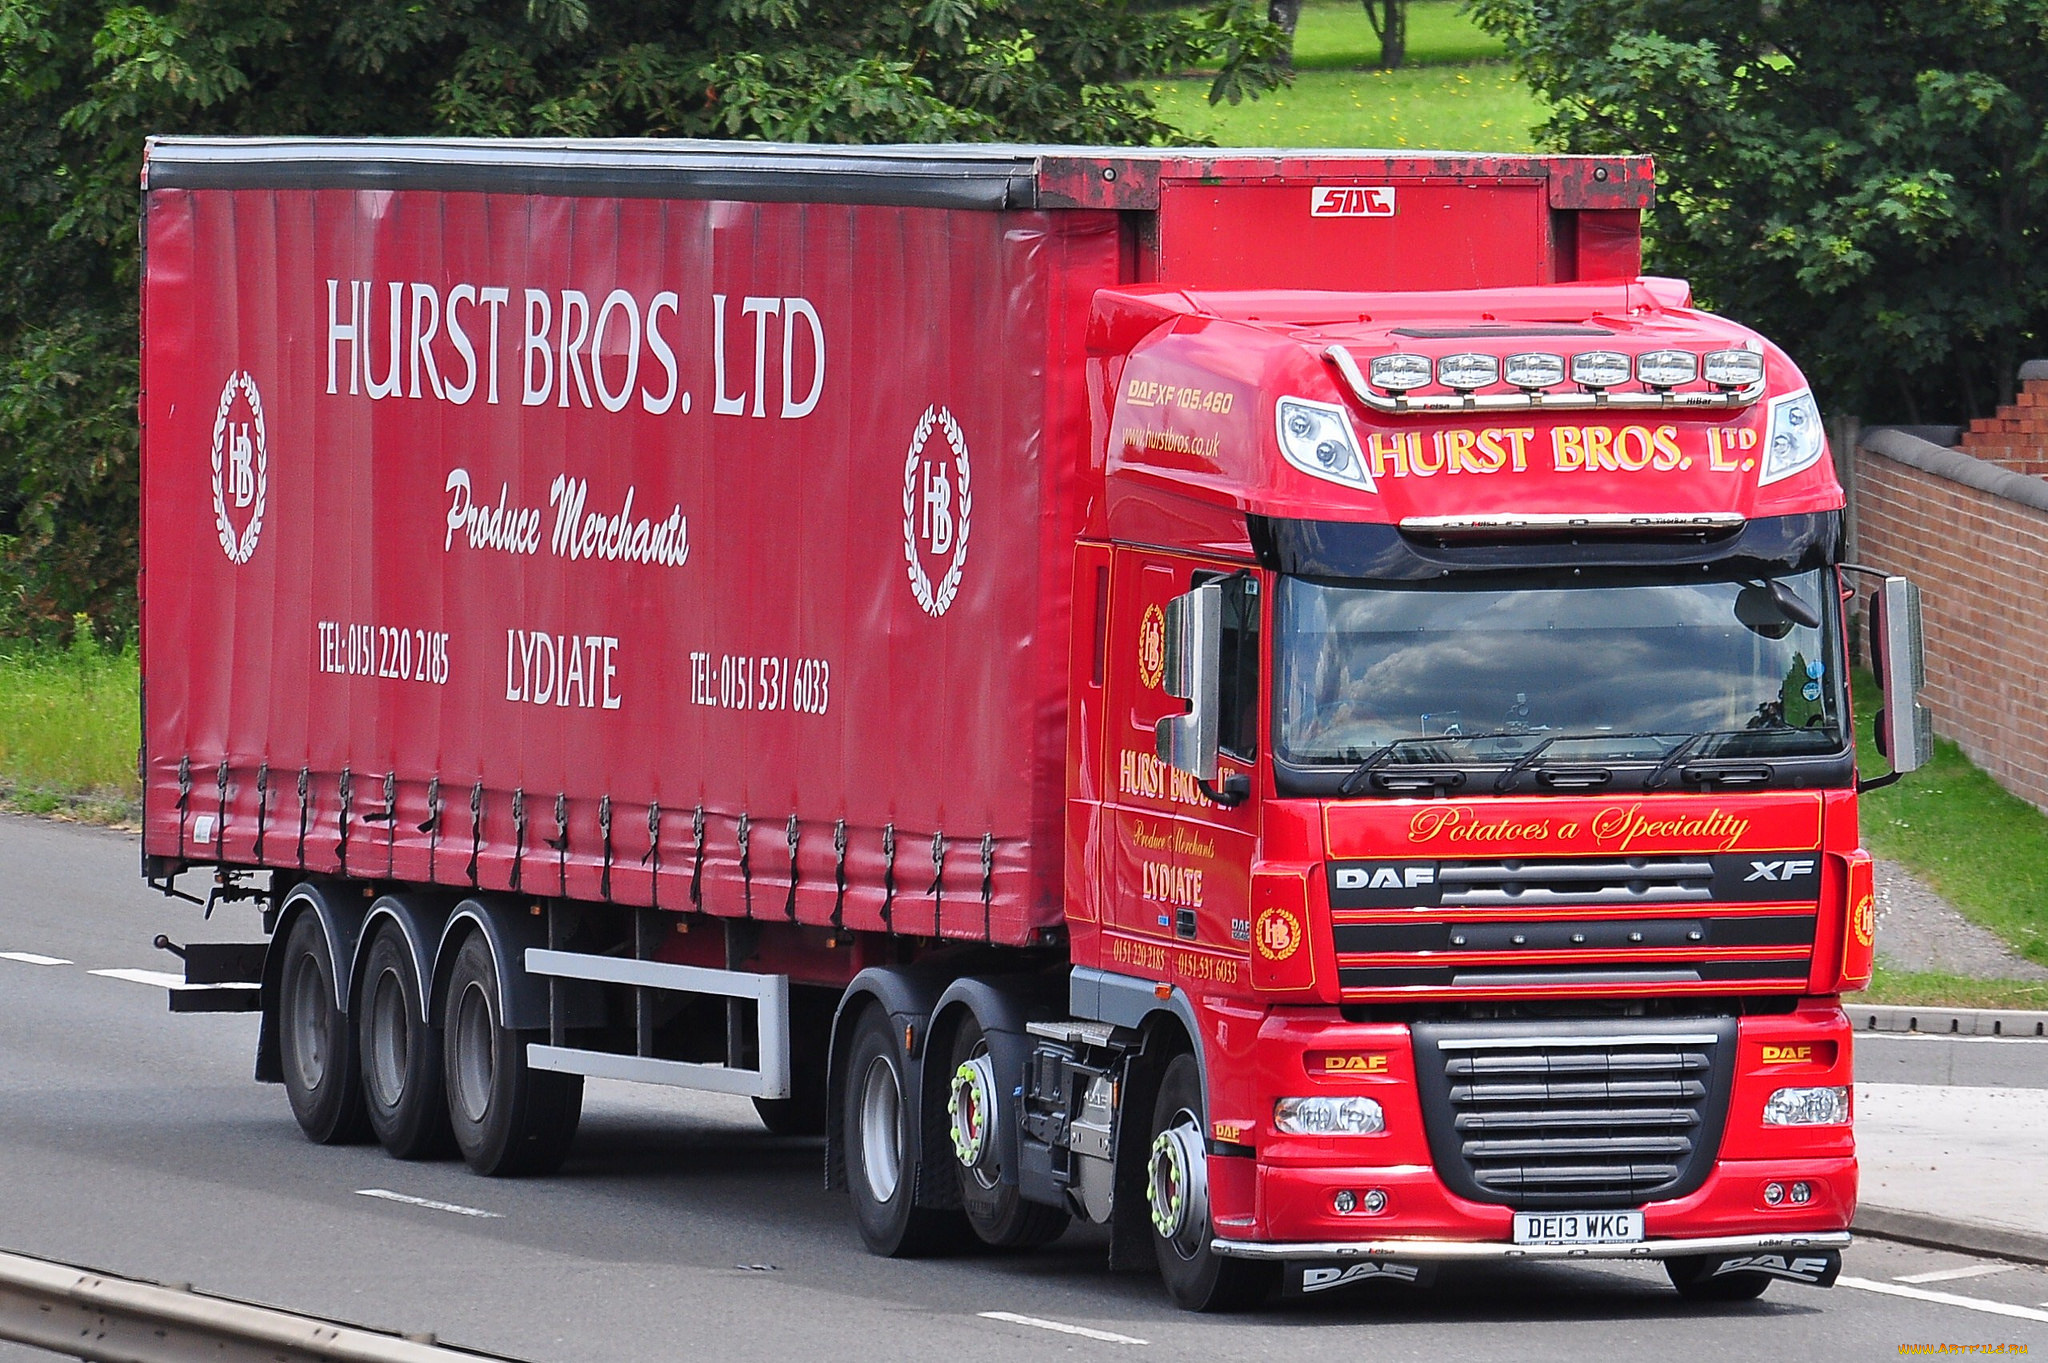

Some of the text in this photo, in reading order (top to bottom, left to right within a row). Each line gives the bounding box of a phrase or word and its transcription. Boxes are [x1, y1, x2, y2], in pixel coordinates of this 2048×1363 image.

[1315, 189, 1391, 214] SDC
[326, 279, 825, 420] HURST BROS. LTD
[1127, 380, 1233, 414] DAF XF 105.460
[1122, 422, 1220, 457] www.hurstbros.co.uk
[1366, 427, 1535, 478] HURST
[1550, 424, 1693, 473] BROS.
[445, 468, 690, 567] Produce Merchants
[318, 621, 449, 685] TEL: 0151 220 2185
[506, 629, 622, 709] LYDIATE
[690, 652, 830, 715] TEL: 0151 531 6033
[1120, 749, 1166, 799] HURST
[1134, 819, 1215, 859] Produce Merchants
[1408, 802, 1751, 851] Potatoes a Speciality
[1143, 860, 1203, 907] LYDIATE
[1335, 867, 1435, 889] DAF
[1743, 859, 1815, 881] XF
[1232, 918, 1249, 932] DAF
[1113, 939, 1165, 970] 0151 220 2185
[1178, 953, 1237, 984] 0151 531 6033
[1325, 1056, 1388, 1072] DAF
[1763, 1046, 1811, 1061] DAF
[1216, 1124, 1240, 1141] DAF
[1528, 1216, 1629, 1238] DE13 WKG
[1303, 1262, 1418, 1289] DAF
[1712, 1254, 1828, 1279] DAF
